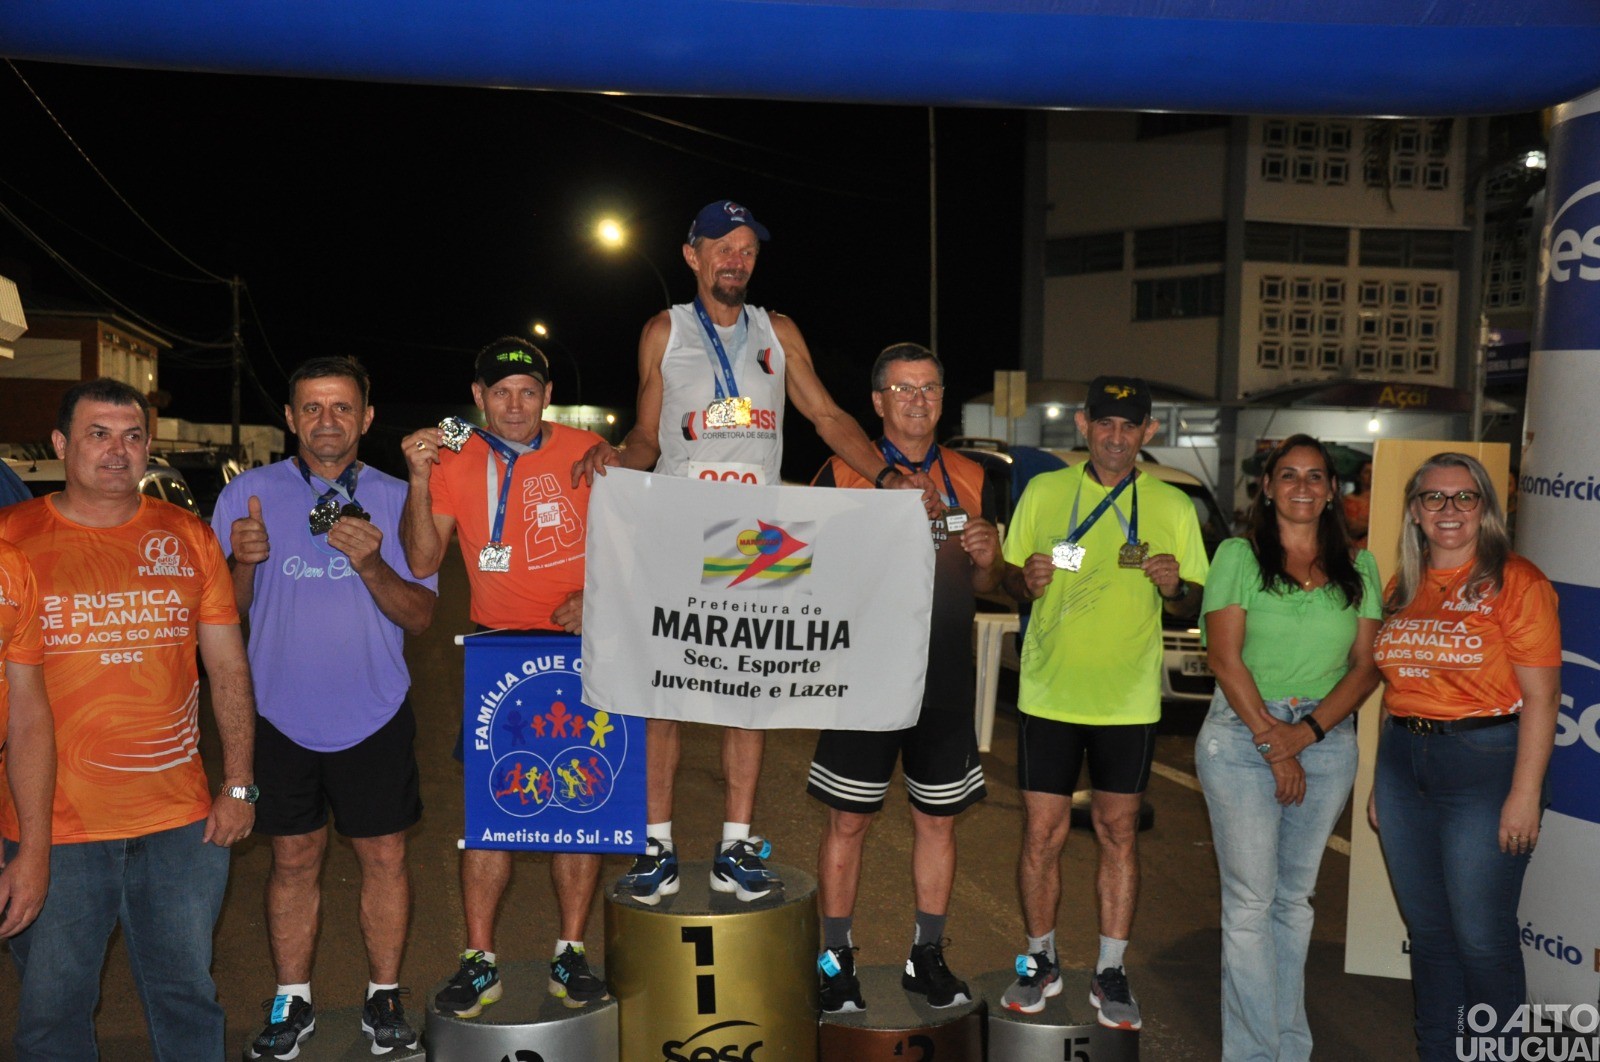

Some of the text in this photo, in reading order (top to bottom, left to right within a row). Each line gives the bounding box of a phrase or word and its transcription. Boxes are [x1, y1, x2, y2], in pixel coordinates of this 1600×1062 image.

[702, 432, 745, 440] CORRETORA
[523, 474, 562, 504] 20
[138, 566, 194, 577] PLANALTO
[282, 555, 324, 580] Vem
[74, 590, 182, 610] RÚSTICA
[688, 597, 822, 615] Prefeitura de
[1442, 600, 1493, 615] PLANALTO
[71, 607, 190, 628] PLANALTO
[1389, 618, 1468, 635] RÚSTICA
[44, 627, 190, 646] UMO AOS 60 ANOS
[651, 606, 850, 651] MARAVILHA
[1380, 631, 1482, 649] PLANALTO
[100, 651, 144, 665] sesc
[683, 648, 821, 677] Sec. Esporte
[1386, 649, 1412, 660] AOS
[1414, 650, 1434, 660] 60
[1437, 653, 1483, 664] ANOS
[1398, 667, 1430, 679] sesc
[651, 670, 848, 698] Juventude e Lazer
[475, 655, 566, 750] FAMÍLIA QUE
[482, 828, 550, 843] Ametista
[553, 829, 572, 843] do
[576, 829, 600, 843] Sul
[613, 830, 634, 845] RS
[554, 963, 571, 984] FILA
[681, 926, 716, 1015] 1
[472, 970, 493, 993] FILA
